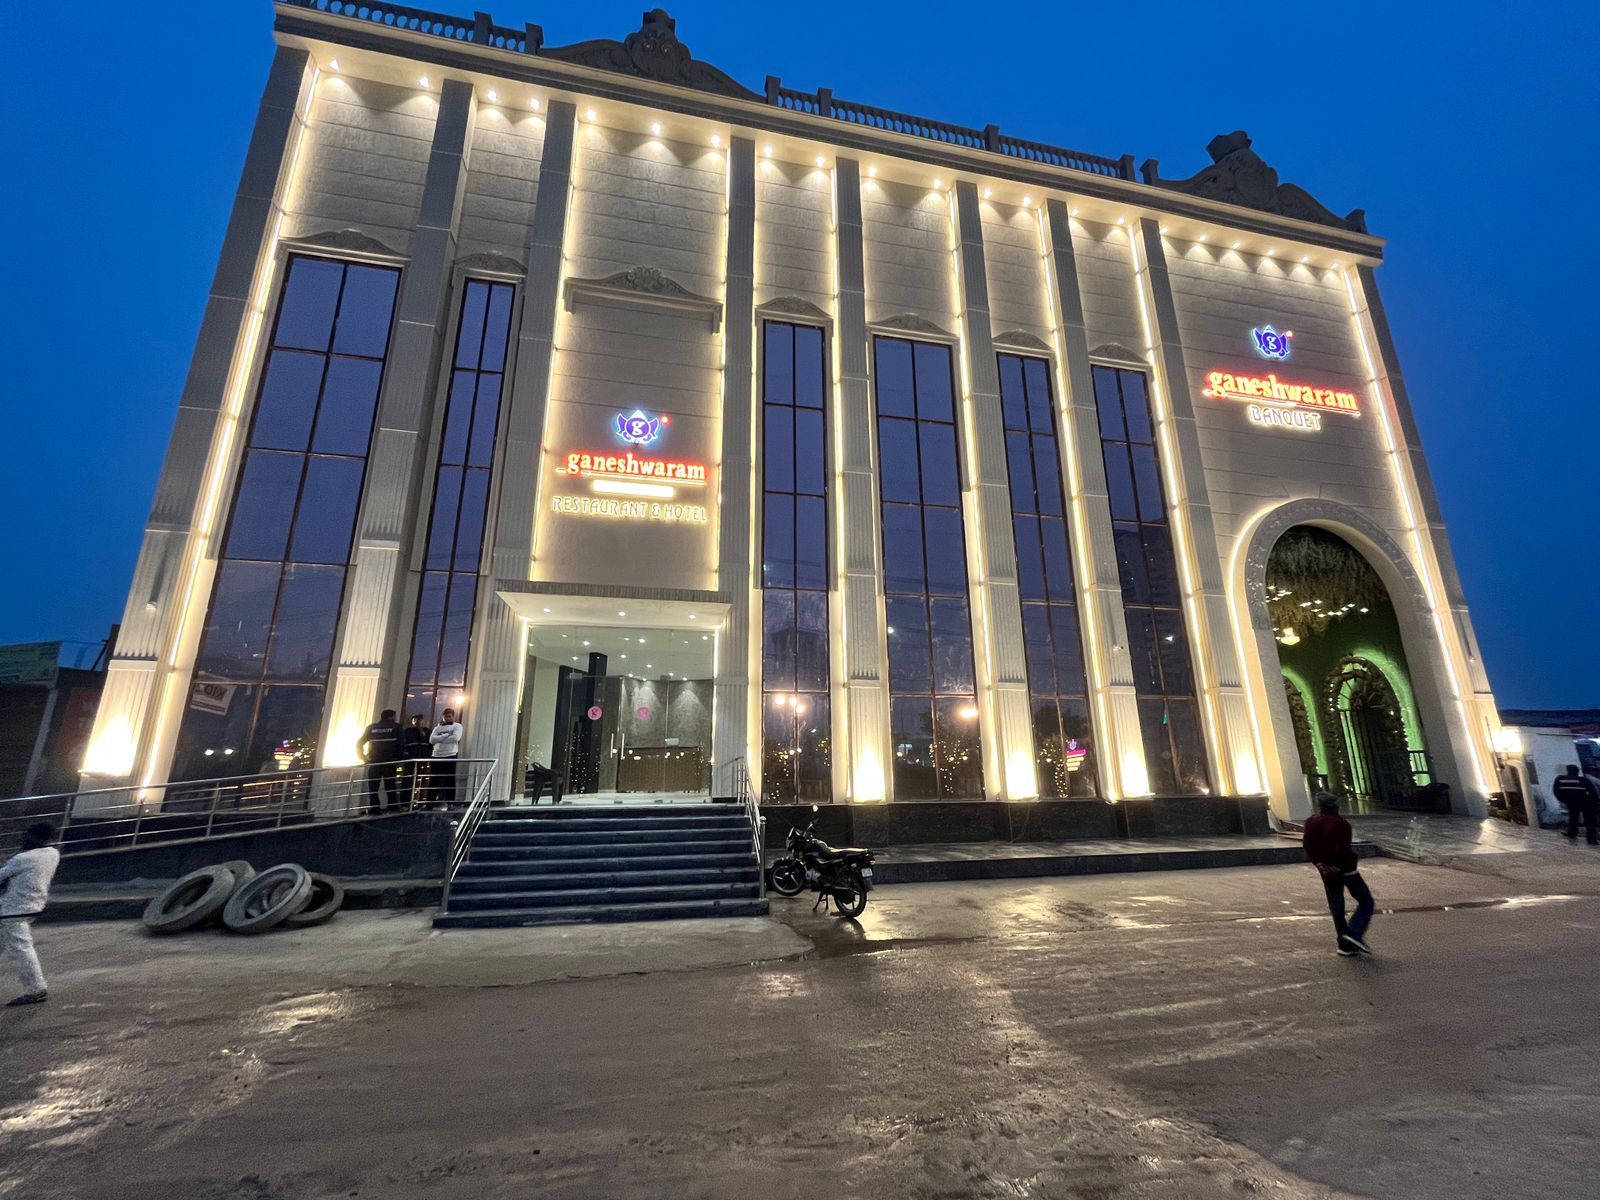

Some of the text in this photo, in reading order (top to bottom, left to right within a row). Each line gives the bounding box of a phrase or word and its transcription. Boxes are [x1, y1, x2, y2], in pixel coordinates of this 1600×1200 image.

[1208, 371, 1359, 411] ganeshwaram
[1249, 405, 1321, 431] BANQUET
[567, 453, 705, 480] ganeshwaram
[552, 496, 707, 521] RESTAURANT & HOTEL
